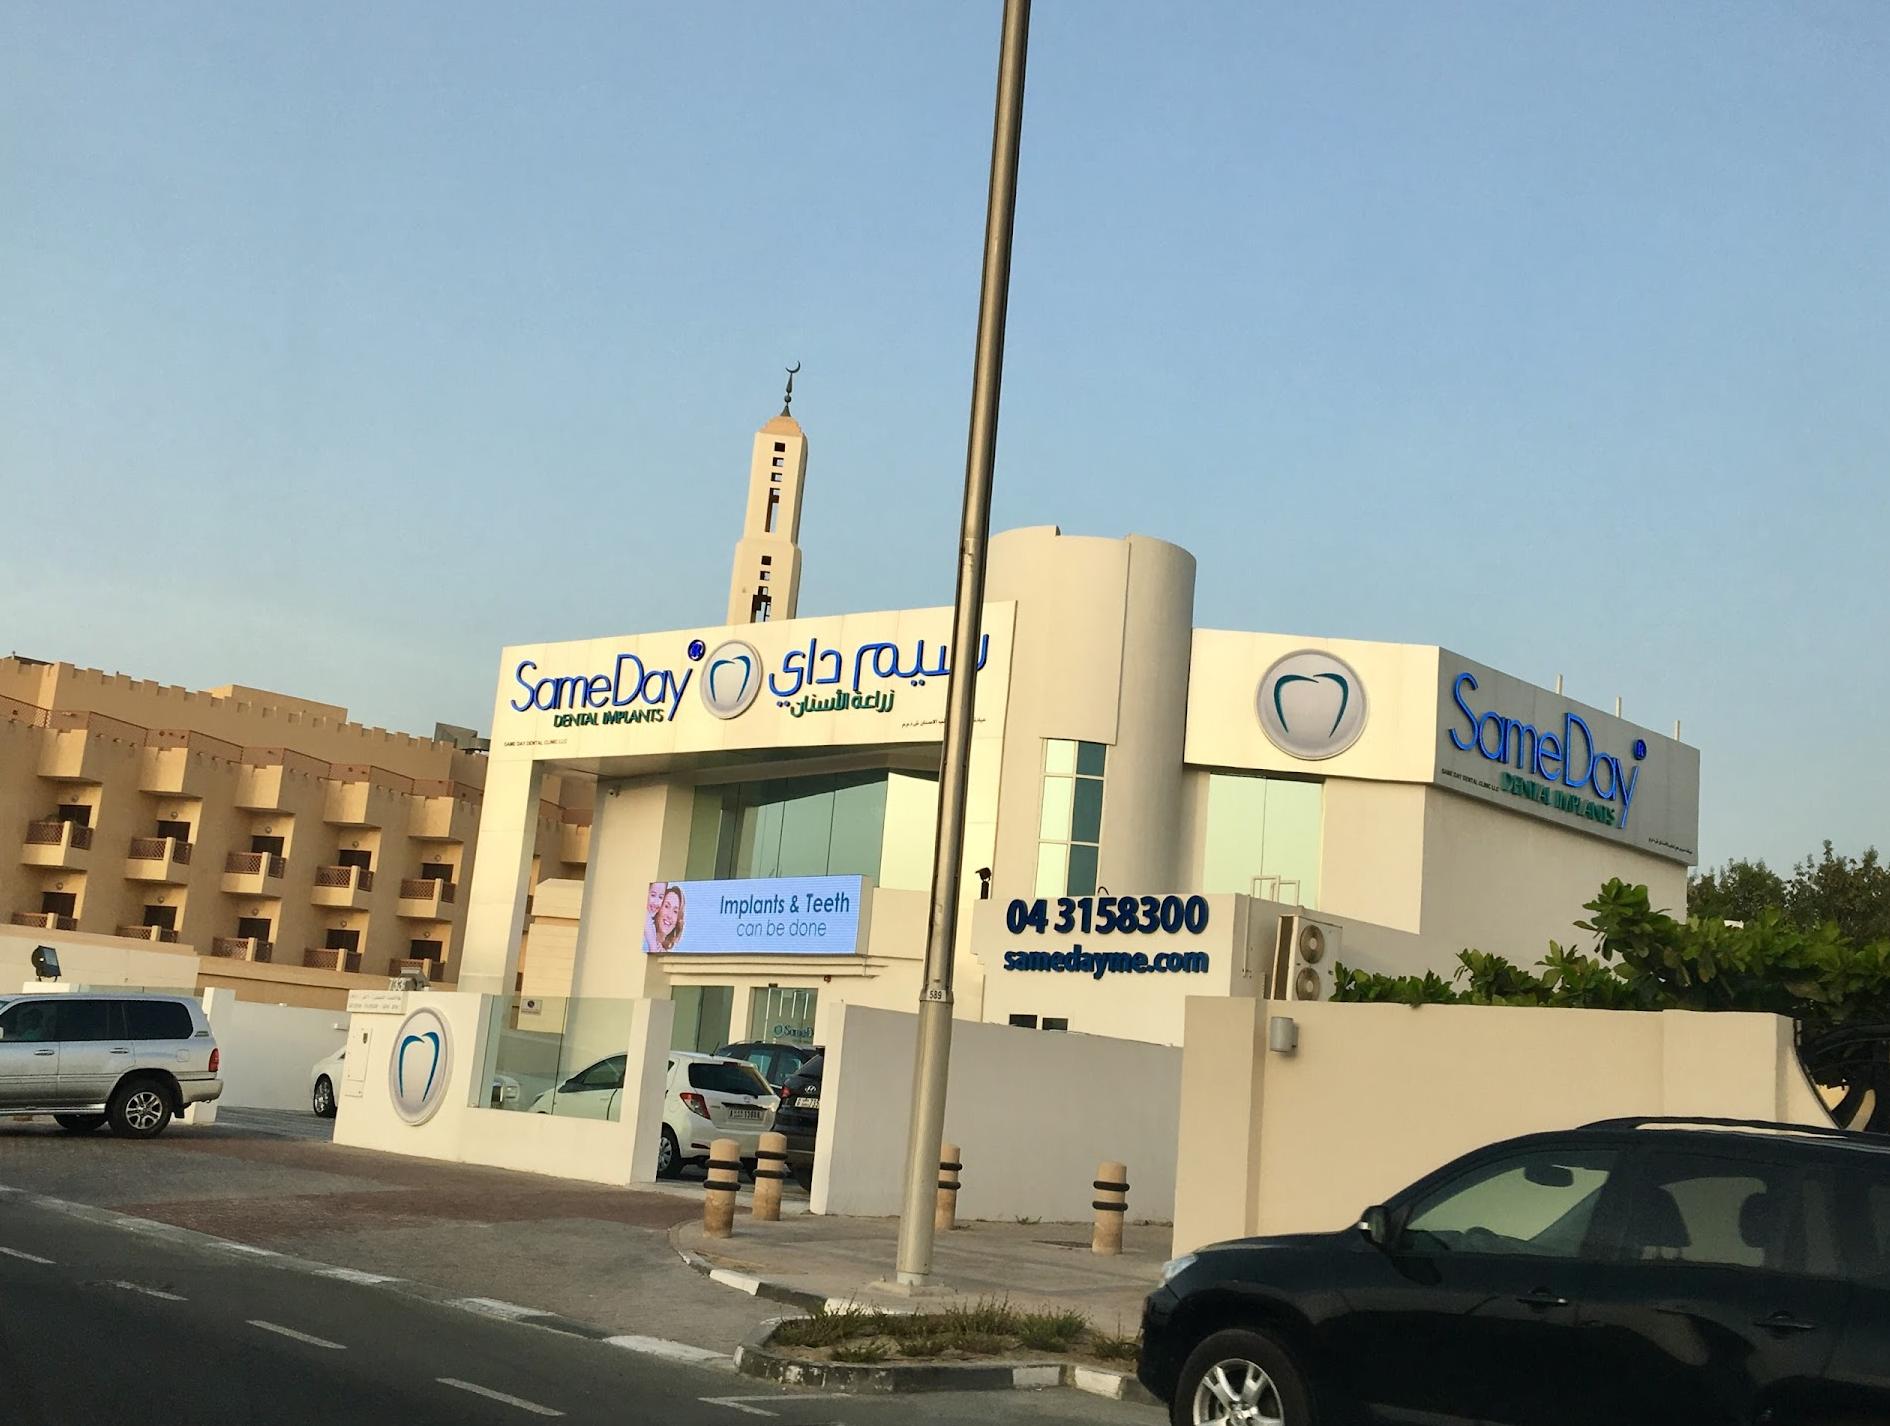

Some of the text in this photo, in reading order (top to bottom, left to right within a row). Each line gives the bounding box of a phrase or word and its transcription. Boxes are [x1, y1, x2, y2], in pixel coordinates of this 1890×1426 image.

[511, 653, 693, 722] SameDay
[850, 689, 895, 713] زراعة
[553, 708, 664, 728] DENTAL IMPLANTS
[1448, 672, 1640, 829] SameDay
[720, 892, 850, 919] Implants & Teeth
[1006, 895, 1210, 934] 04 3158300
[736, 919, 827, 937] can be done
[1003, 944, 1210, 980] samedayme.com
